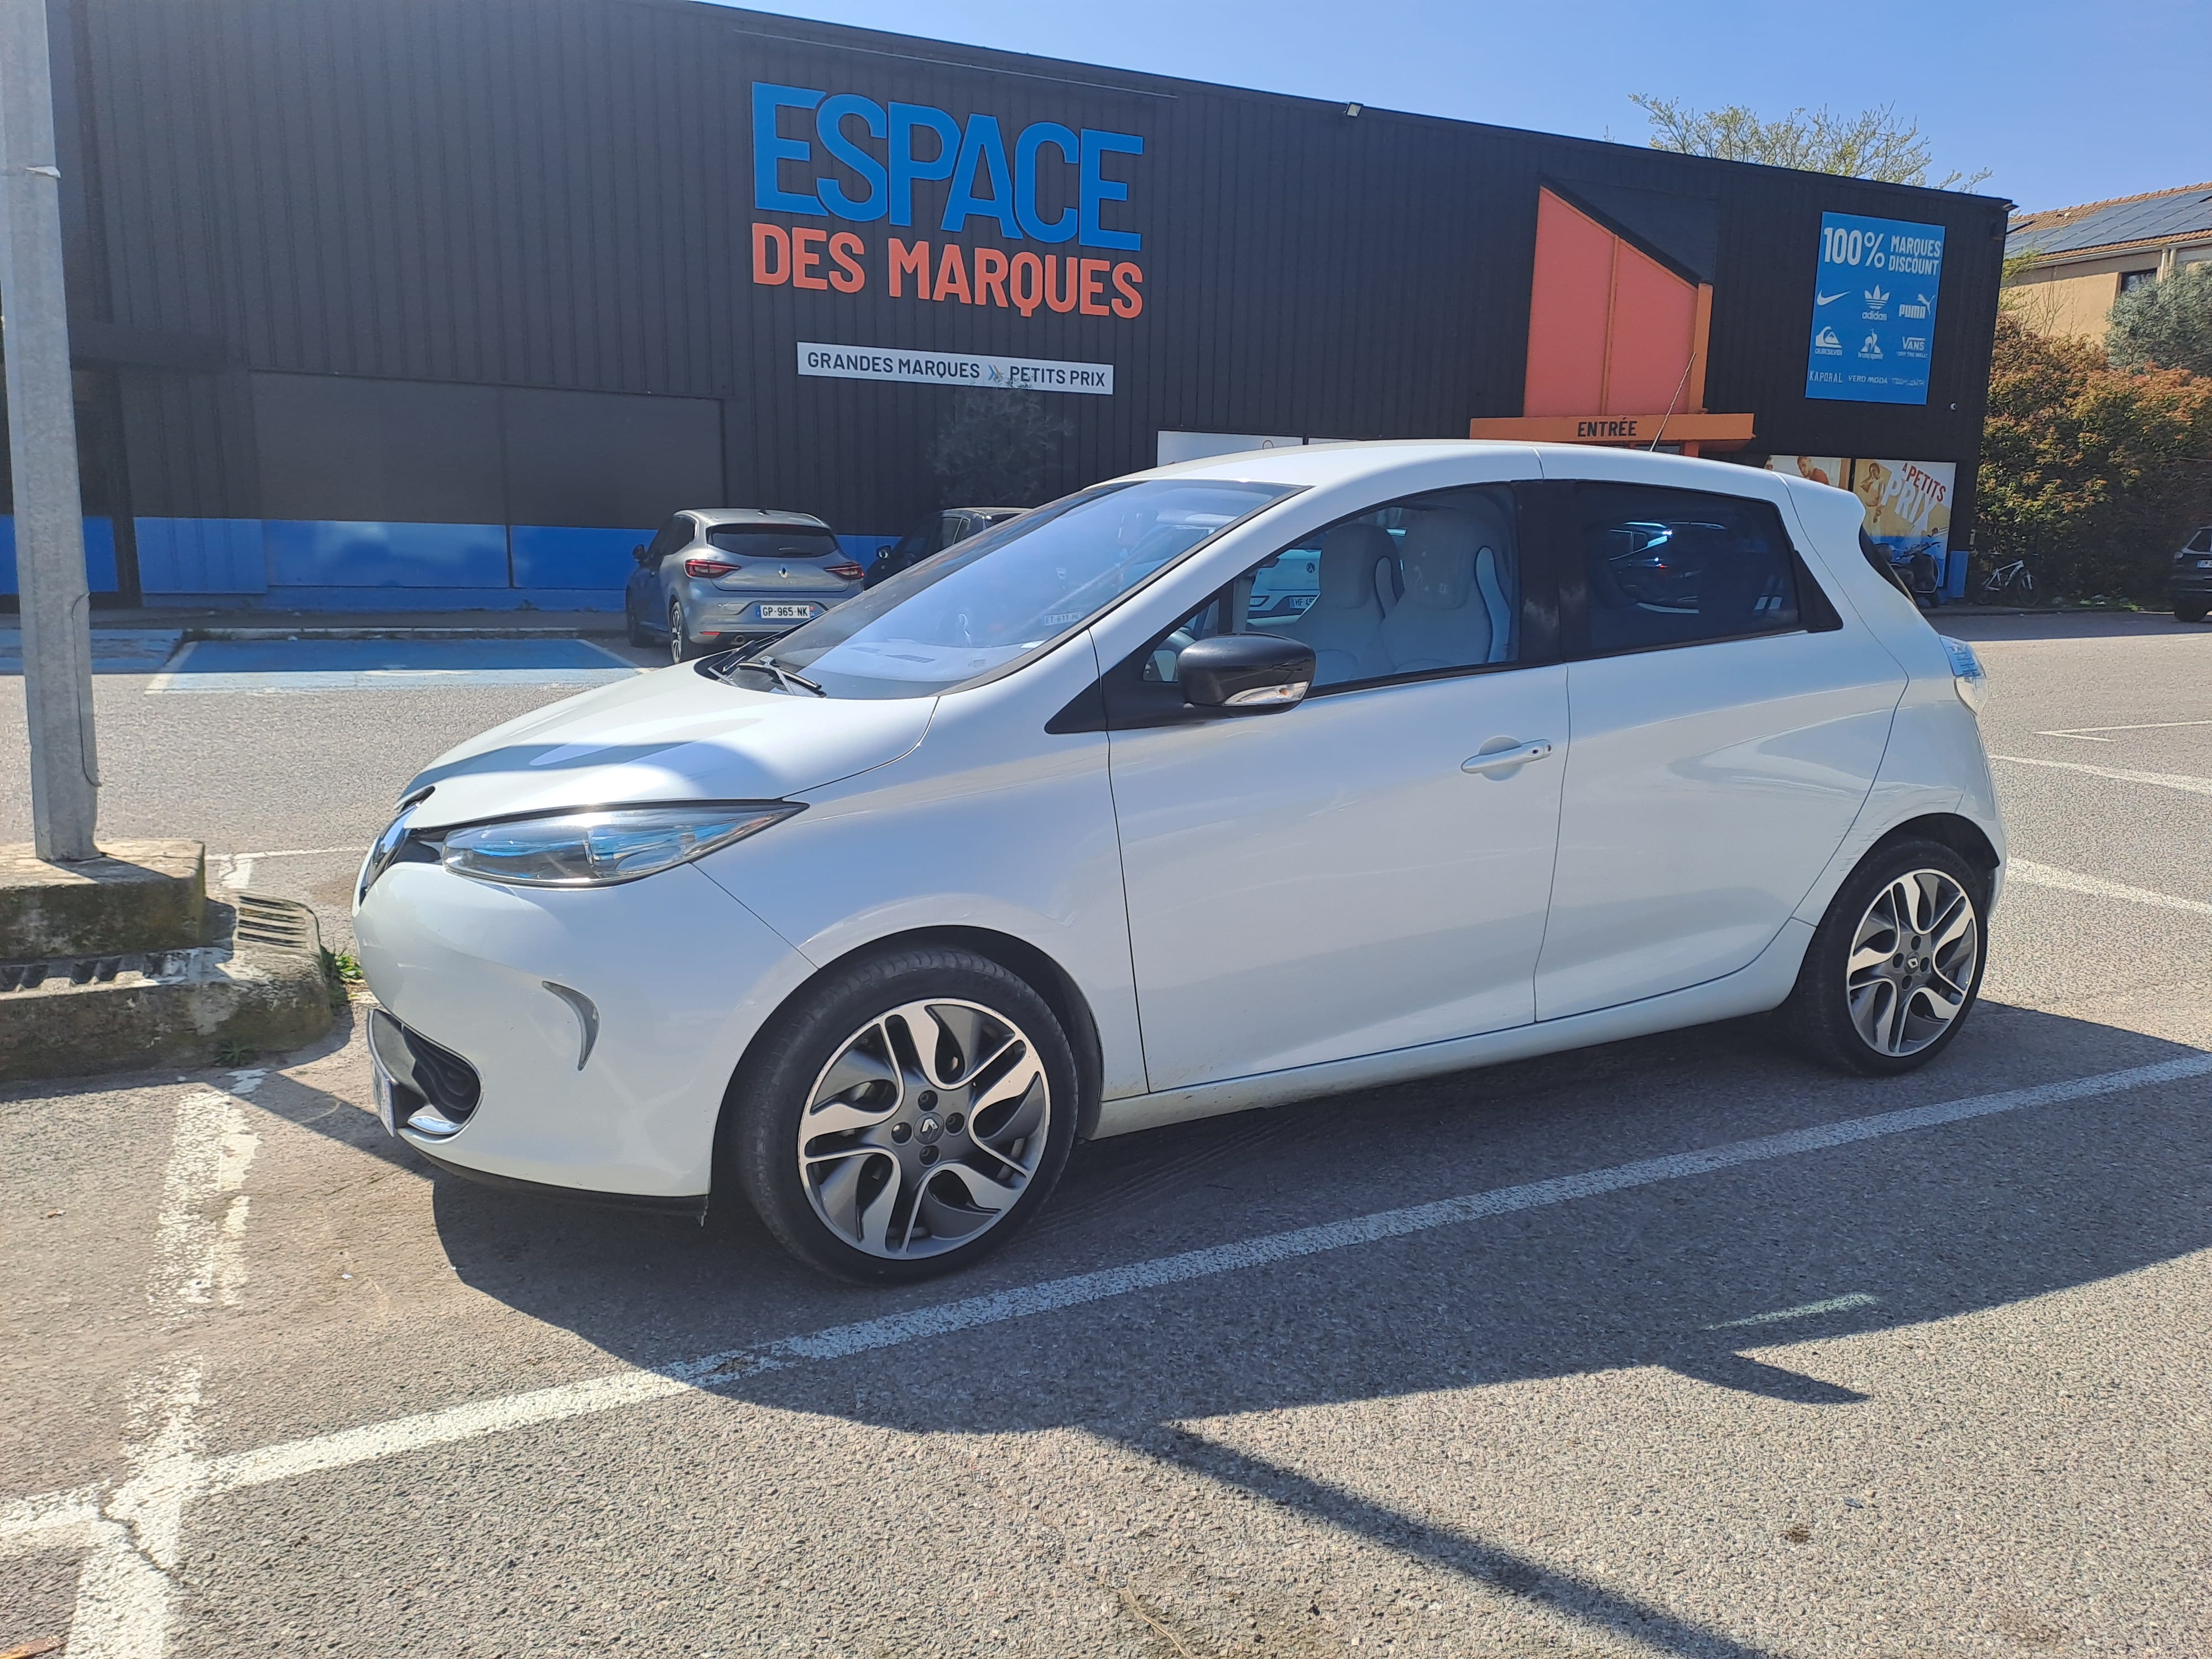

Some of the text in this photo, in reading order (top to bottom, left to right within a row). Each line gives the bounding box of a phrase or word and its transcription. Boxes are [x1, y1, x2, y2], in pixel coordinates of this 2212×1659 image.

[752, 81, 1144, 251] ESPACE
[1824, 227, 1942, 268] 100% MARQUES
[752, 222, 1143, 319] DES MARQUES
[1888, 255, 1939, 276] DISCOUNT
[1862, 310, 1887, 321] adidas
[1898, 304, 1926, 319] PUMA
[1902, 336, 1926, 351] VANS
[807, 352, 1105, 387] GRANDES MARQUES PETITS PRIX
[1809, 370, 1843, 383] KAPORAL
[1867, 376, 1888, 384] MODA
[1577, 416, 1637, 437] ENTRÉE
[1906, 465, 1946, 502] PETITS
[763, 607, 808, 617] GP-965-NK
